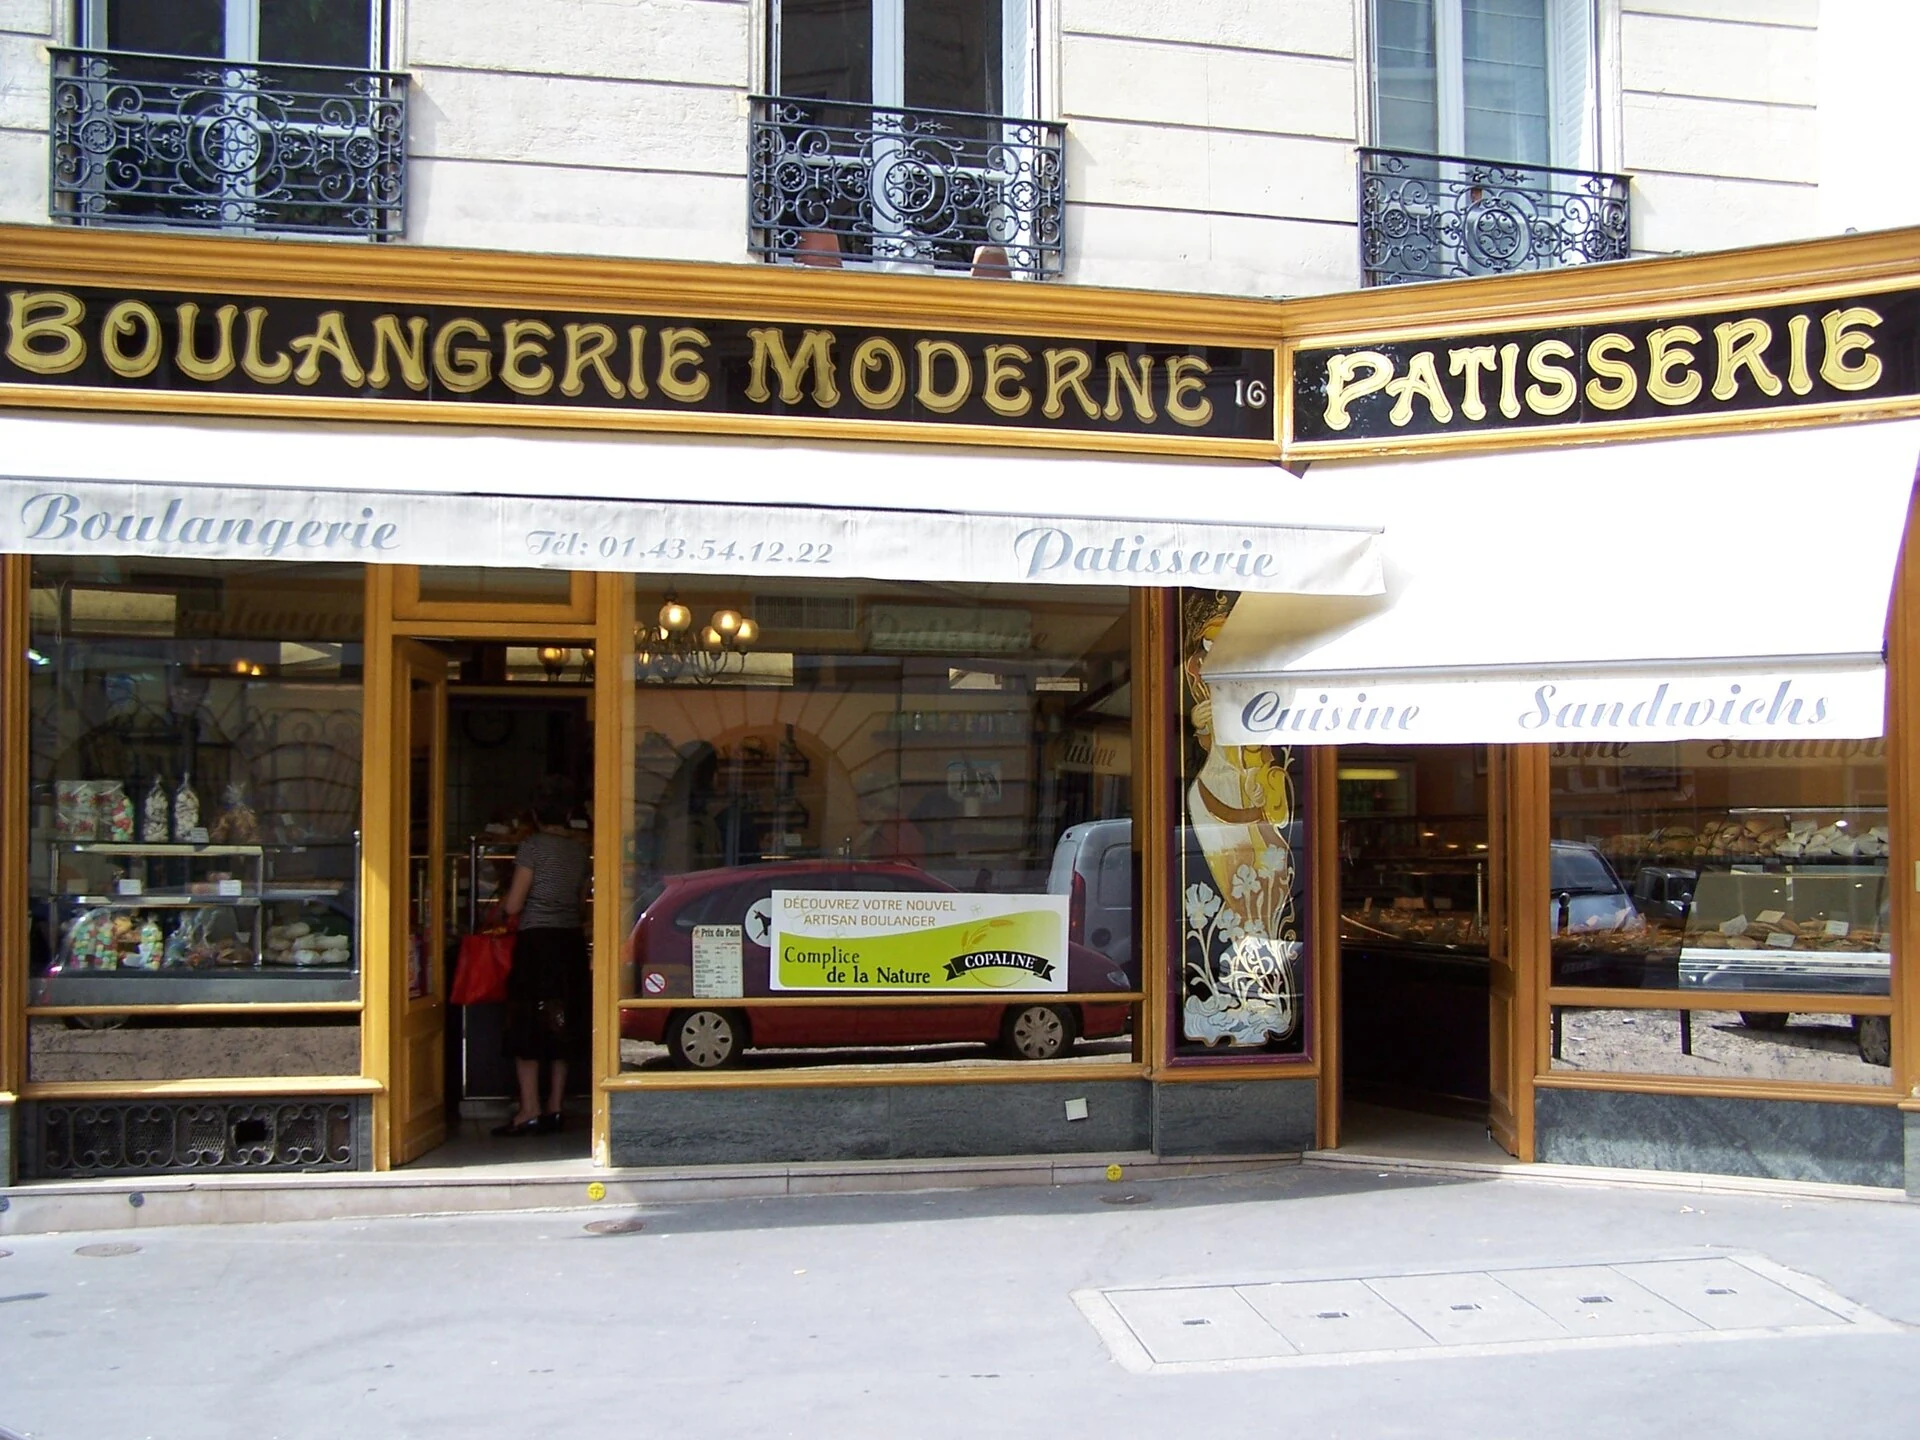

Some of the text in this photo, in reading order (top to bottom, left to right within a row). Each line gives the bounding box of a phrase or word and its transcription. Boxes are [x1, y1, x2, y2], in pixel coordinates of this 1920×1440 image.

[6, 290, 1213, 427] BOULANGERIE MODERNE
[1324, 307, 1884, 431] PATISSERIE
[1233, 379, 1266, 408] 16
[21, 492, 401, 558] Boulangerie
[526, 530, 834, 563] Tél: 01.43.54.12.22
[1013, 525, 1280, 579] Patisserie
[1241, 679, 1832, 734] Cuisine Sandwichs
[783, 896, 956, 911] DÉCOUVREZ VOTRE NOUVEL
[701, 928, 714, 938] Prix
[804, 914, 936, 926] ARTISAN BOULANGER
[784, 946, 860, 969] Complice
[964, 952, 1035, 969] COPALINE
[826, 965, 931, 984] de la Nature
